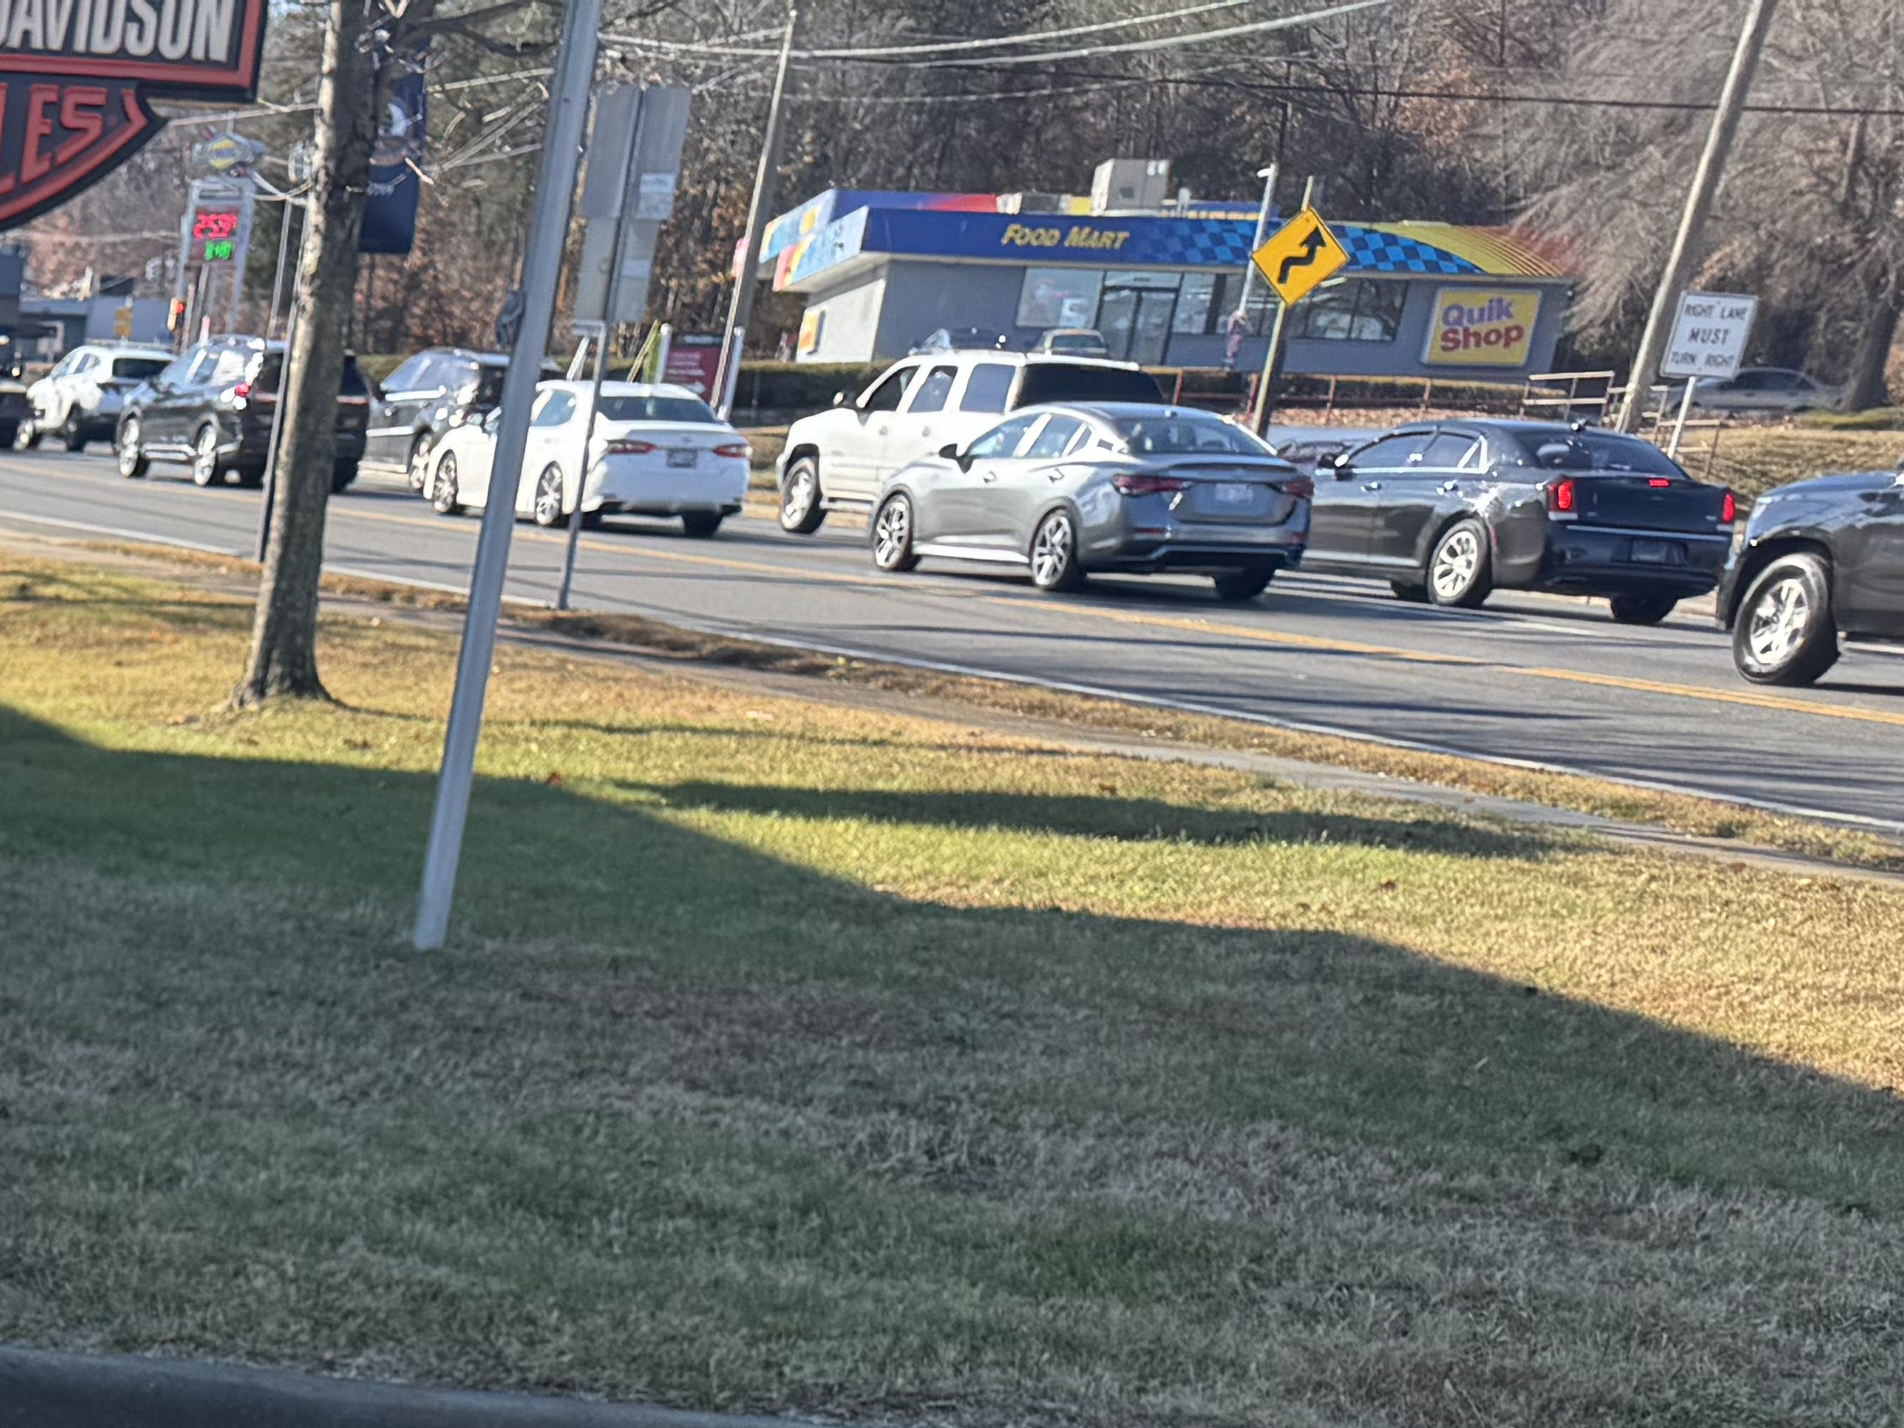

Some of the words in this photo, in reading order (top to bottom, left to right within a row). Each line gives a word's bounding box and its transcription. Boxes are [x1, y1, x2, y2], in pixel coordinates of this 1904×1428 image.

[1000, 223, 1061, 247] FOOD
[1063, 225, 1130, 250] MART
[1441, 297, 1515, 328] Quik
[1685, 303, 1714, 318] RIGHT
[1720, 306, 1748, 320] LANE
[1439, 324, 1525, 352] Shop
[1688, 327, 1729, 345] MUST
